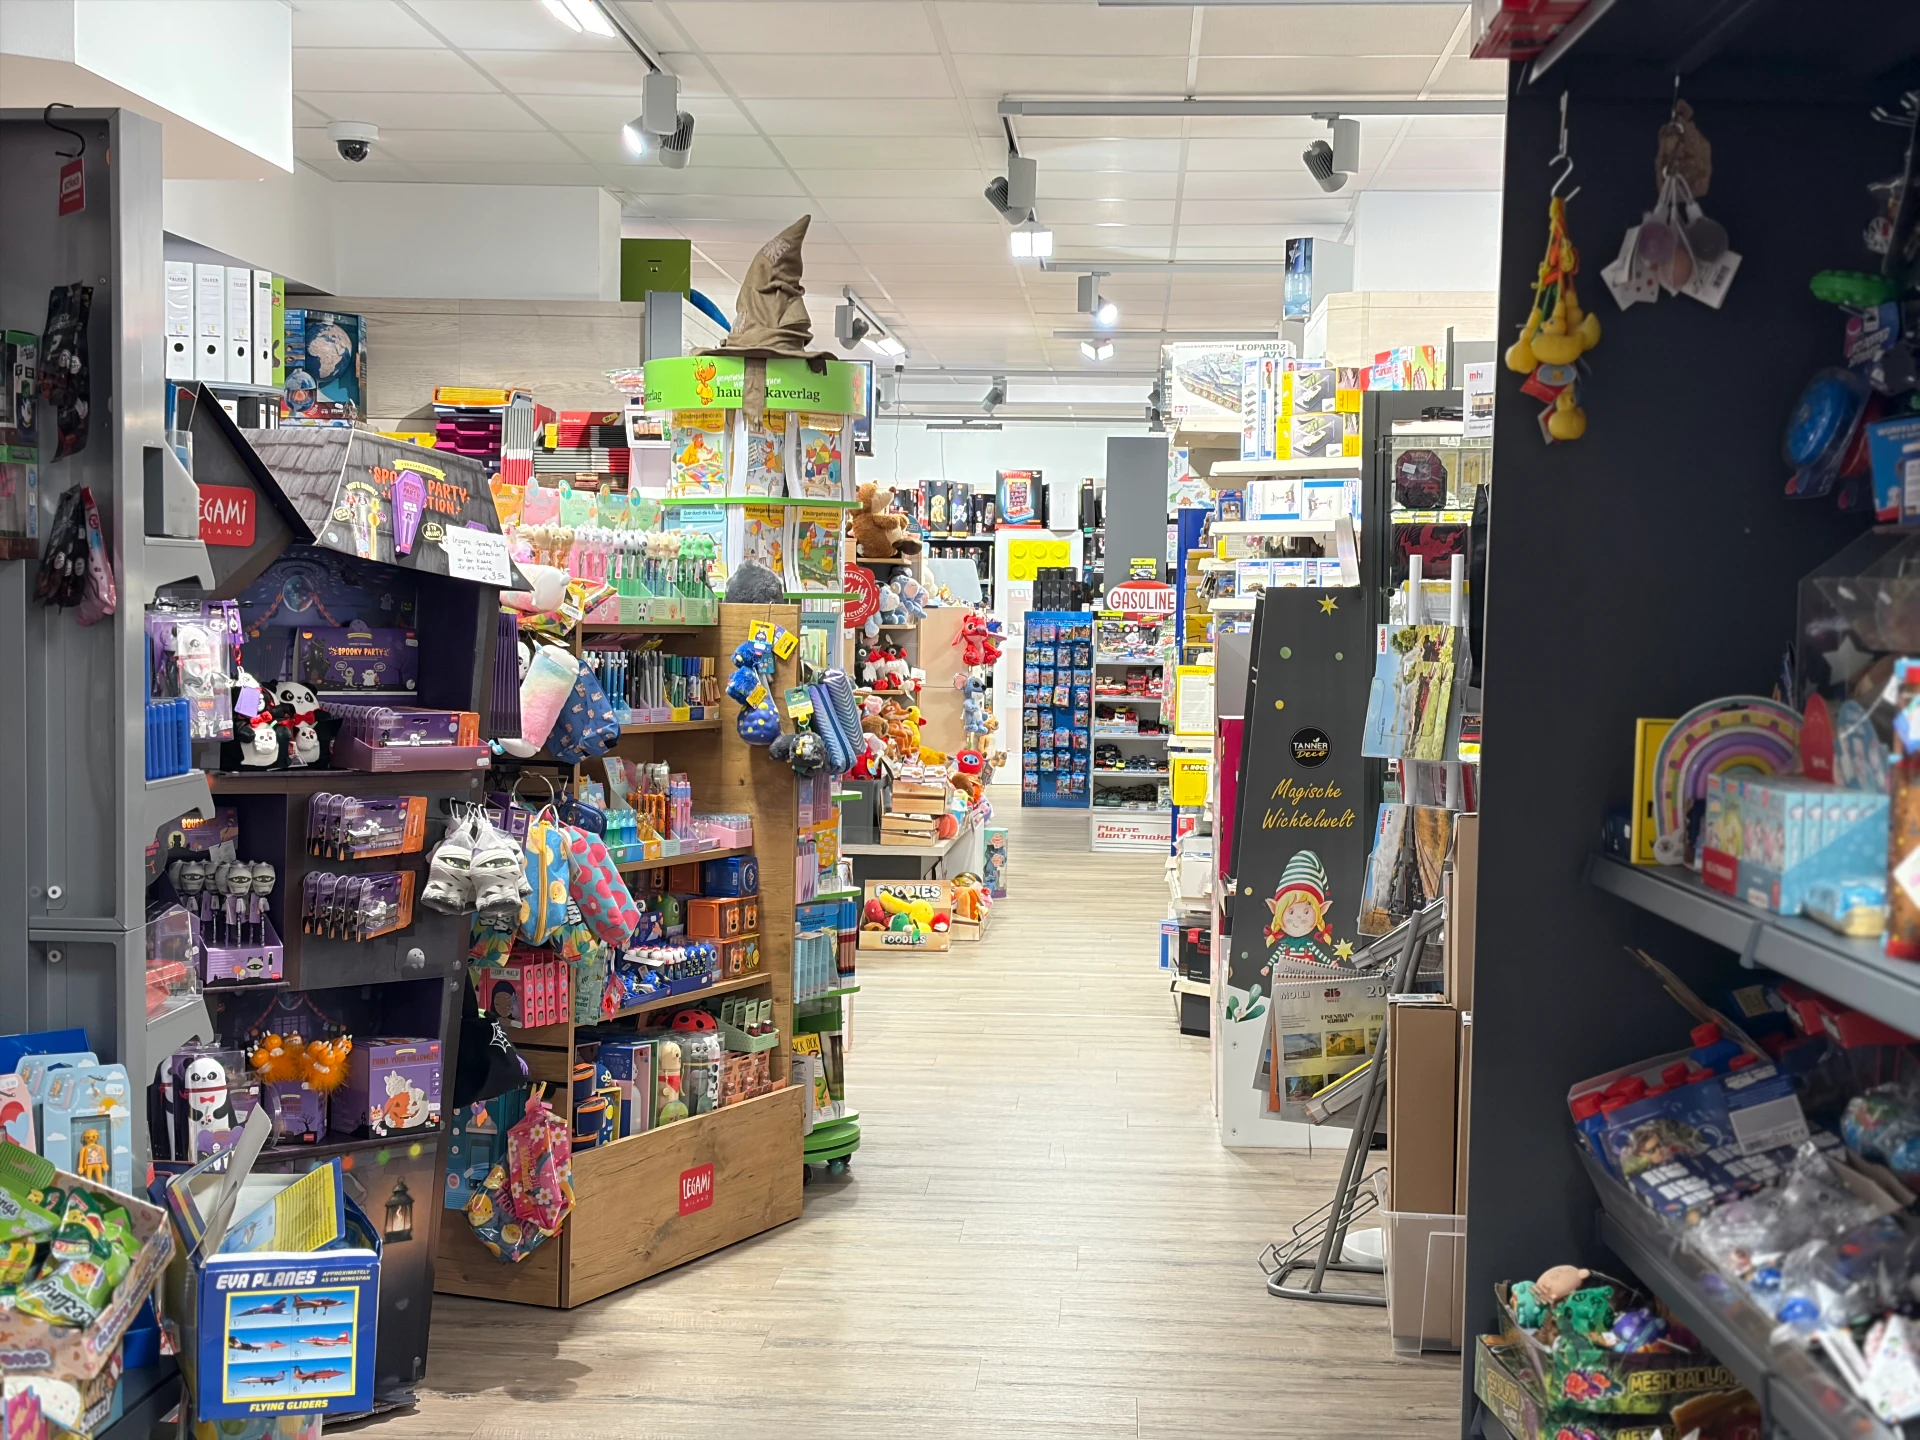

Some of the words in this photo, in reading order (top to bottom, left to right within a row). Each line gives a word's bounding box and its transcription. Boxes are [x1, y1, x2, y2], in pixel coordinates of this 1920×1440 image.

[1235, 343, 1279, 351] LEOPARD
[427, 479, 469, 504] PARTY
[198, 496, 249, 526] EGAMi
[200, 528, 243, 538] ILANO
[1110, 591, 1176, 610] GASOLINE
[338, 647, 363, 656] SPOOKY
[363, 647, 384, 656] PARTY
[1295, 750, 1328, 759] Deco
[1271, 777, 1342, 806] Magische
[1262, 807, 1356, 829] Wichtelwelt
[1097, 824, 1141, 833] Please
[1097, 831, 1127, 839] don't
[321, 1269, 371, 1278] APPROXIMATELY
[215, 1273, 250, 1290] EVA
[251, 1269, 318, 1289] PLANES
[339, 1275, 371, 1283] WINGSPAN
[249, 1401, 285, 1413] FLYING
[286, 1399, 330, 1411] GLIDERS
